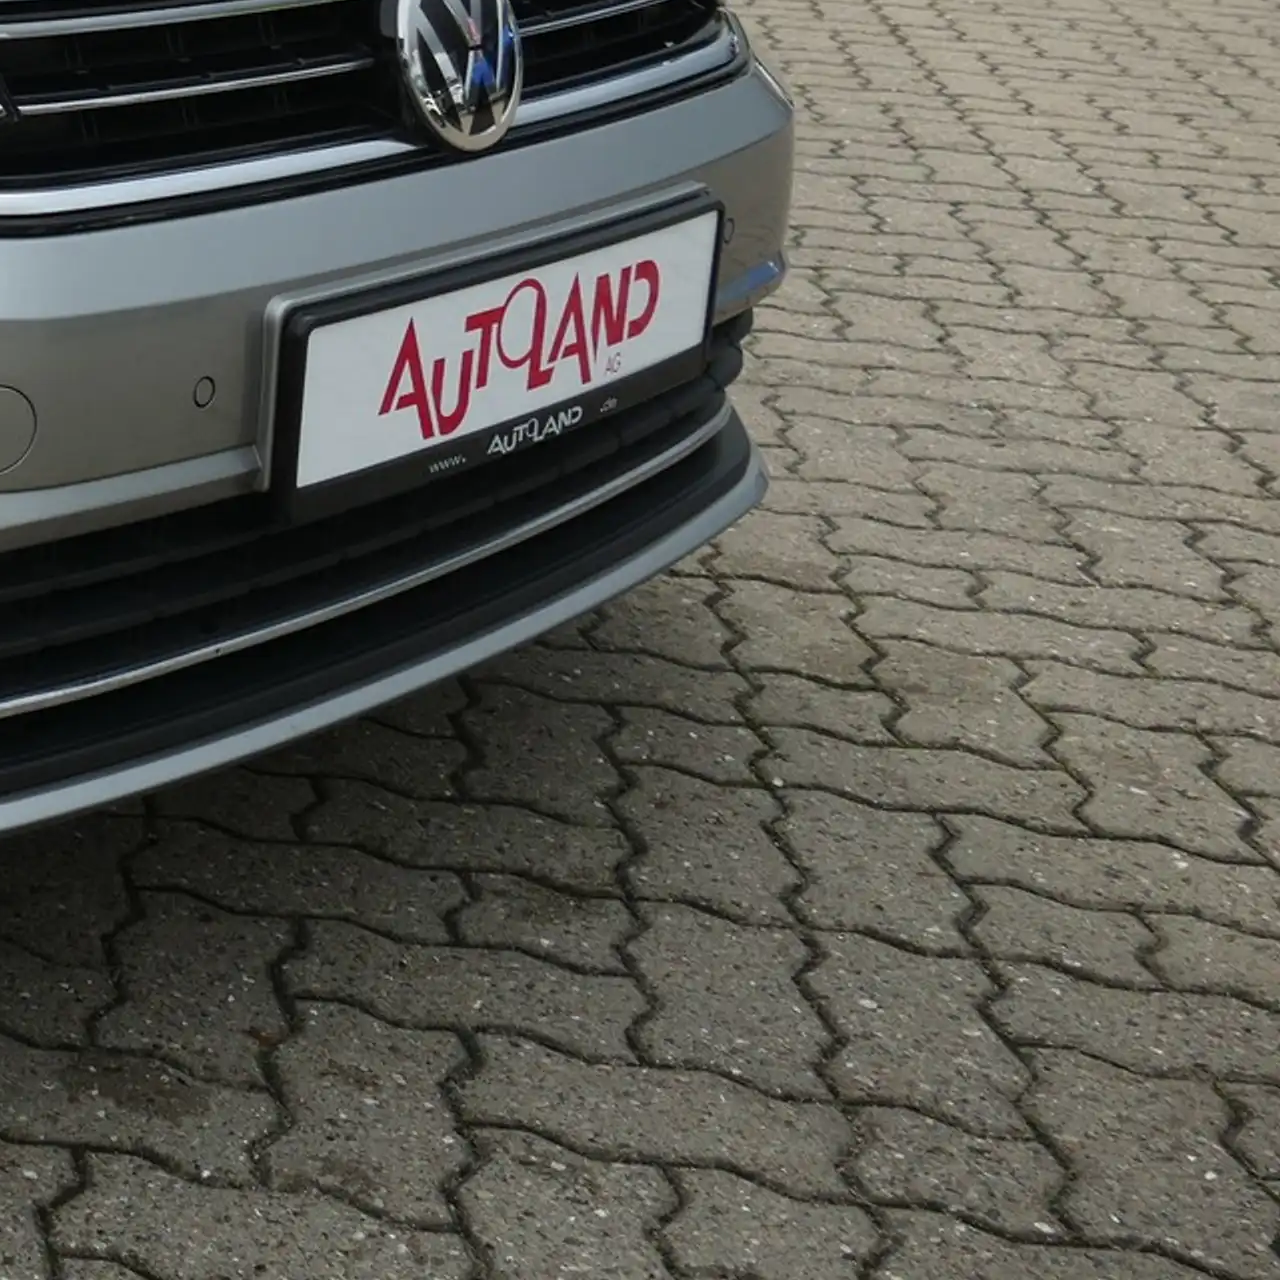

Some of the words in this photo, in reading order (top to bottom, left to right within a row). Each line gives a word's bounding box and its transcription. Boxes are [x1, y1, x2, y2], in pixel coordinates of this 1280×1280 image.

[378, 260, 660, 440] AUTOLAND
[604, 352, 622, 375] AG
[487, 406, 583, 455] AUTOLAND
